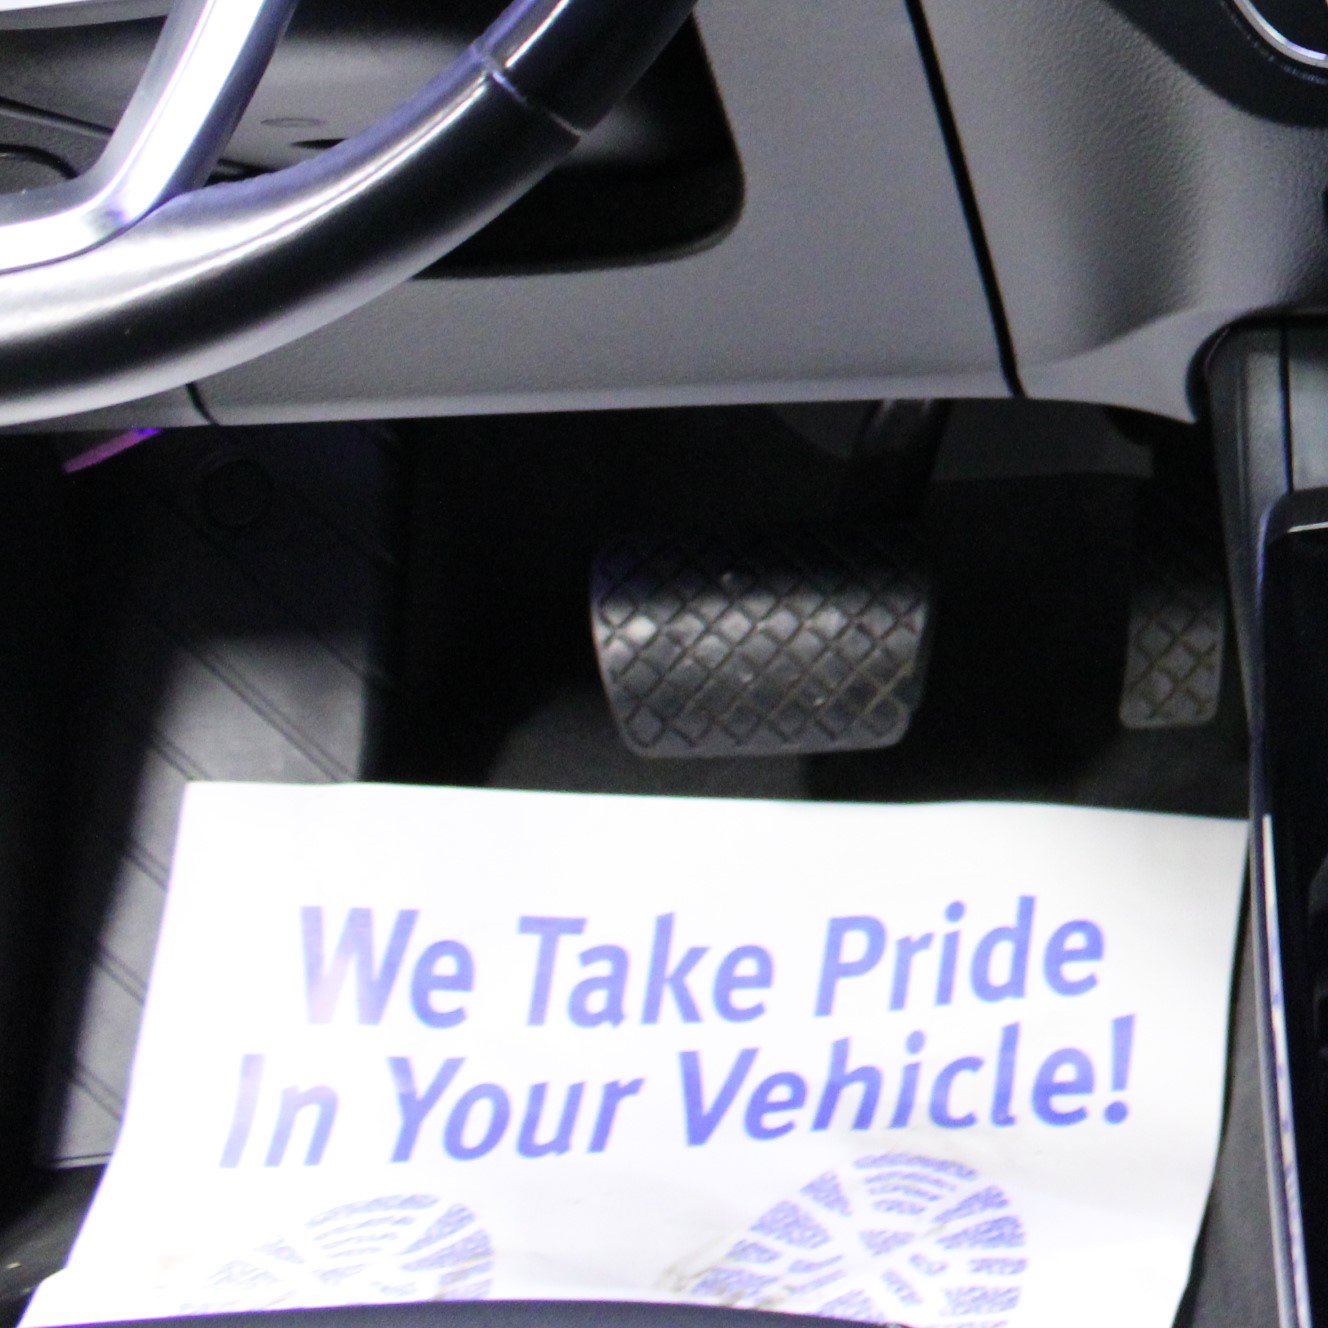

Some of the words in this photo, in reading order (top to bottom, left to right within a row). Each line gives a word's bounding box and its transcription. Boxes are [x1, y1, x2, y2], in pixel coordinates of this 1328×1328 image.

[301, 905, 475, 1030] We
[516, 911, 775, 1030] Take
[812, 894, 1106, 1018] Pride
[218, 1052, 339, 1169] In
[386, 1055, 645, 1164] Your
[677, 1012, 1137, 1148] Vehicle!
